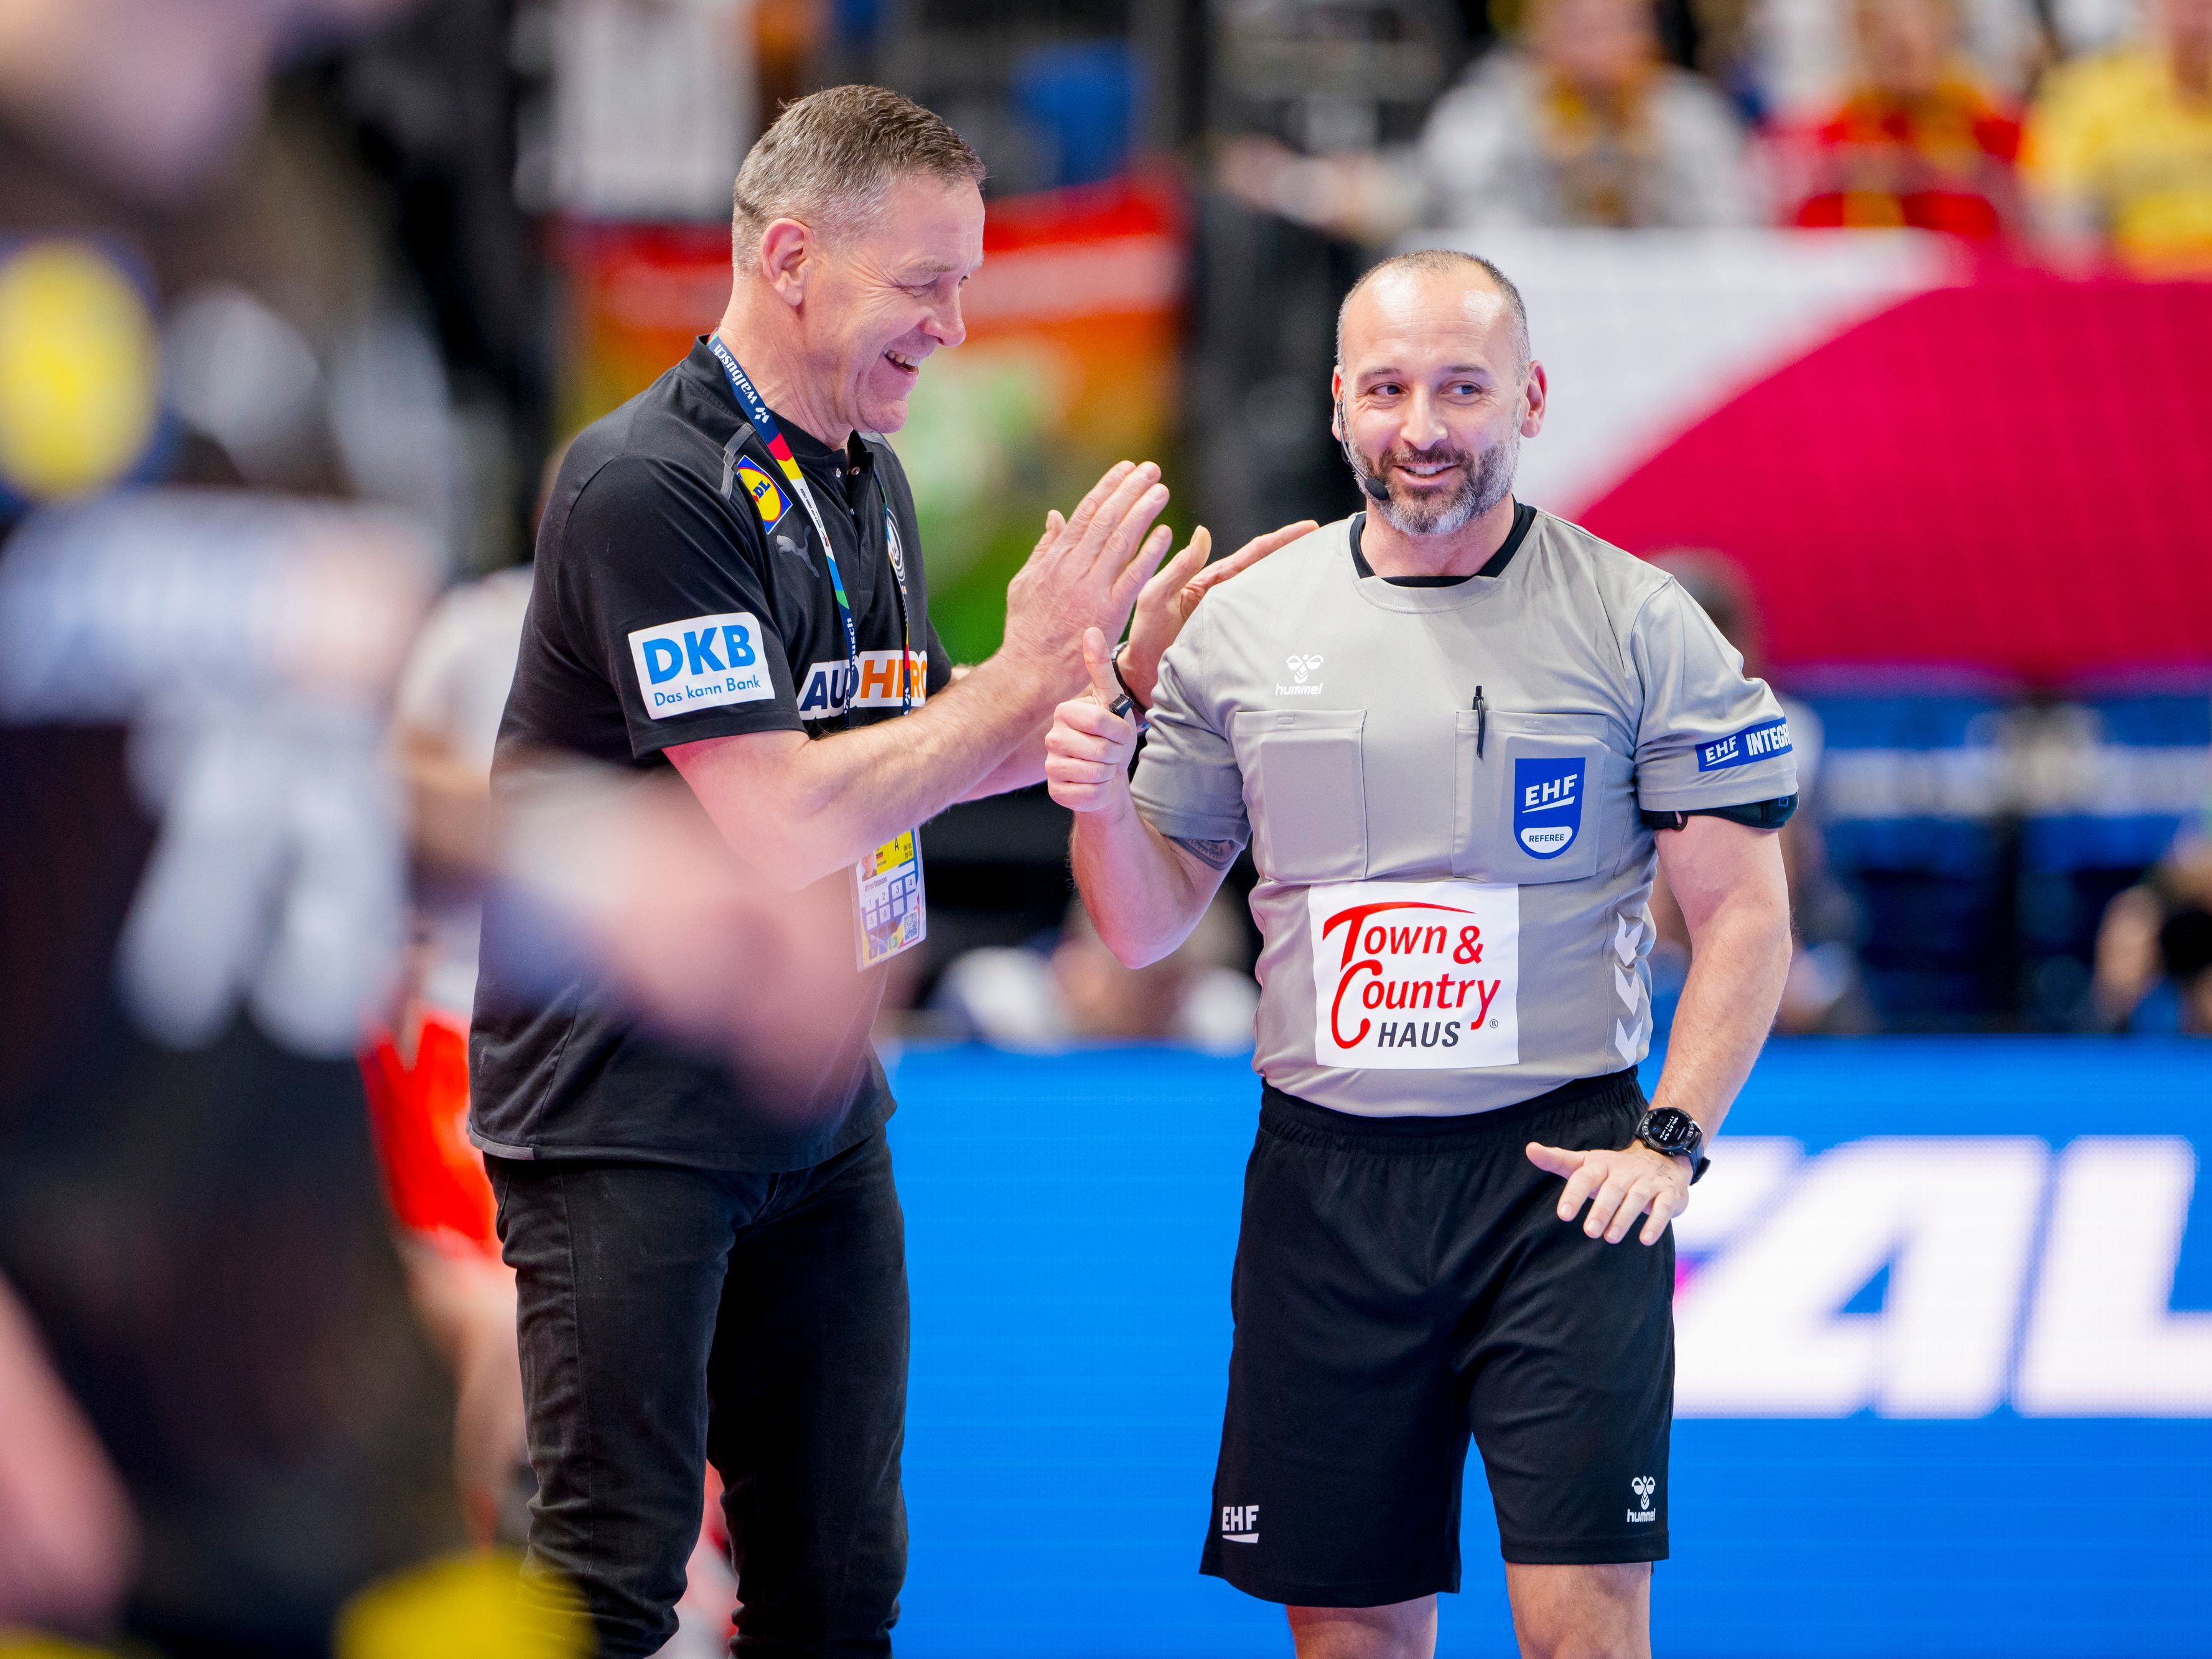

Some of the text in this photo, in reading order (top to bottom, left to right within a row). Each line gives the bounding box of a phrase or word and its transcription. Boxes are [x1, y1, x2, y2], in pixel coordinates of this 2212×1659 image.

[714, 344, 758, 404] walbusch
[642, 624, 756, 685] DKB
[654, 675, 761, 706] Das kann Bank
[1274, 682, 1323, 695] hummel
[1705, 736, 1737, 763] EHF
[1525, 773, 1577, 807] EHF
[1529, 833, 1565, 843] REFEREE
[882, 892, 886, 900] 2
[895, 885, 900, 894] 3
[909, 878, 913, 886] 4
[870, 909, 887, 925] 5 6
[1322, 900, 1484, 974] Town &
[1331, 959, 1501, 1049] Country
[1378, 1021, 1461, 1048] HAUS
[1222, 1505, 1259, 1531] EHF
[1626, 1507, 1656, 1523] hummel
